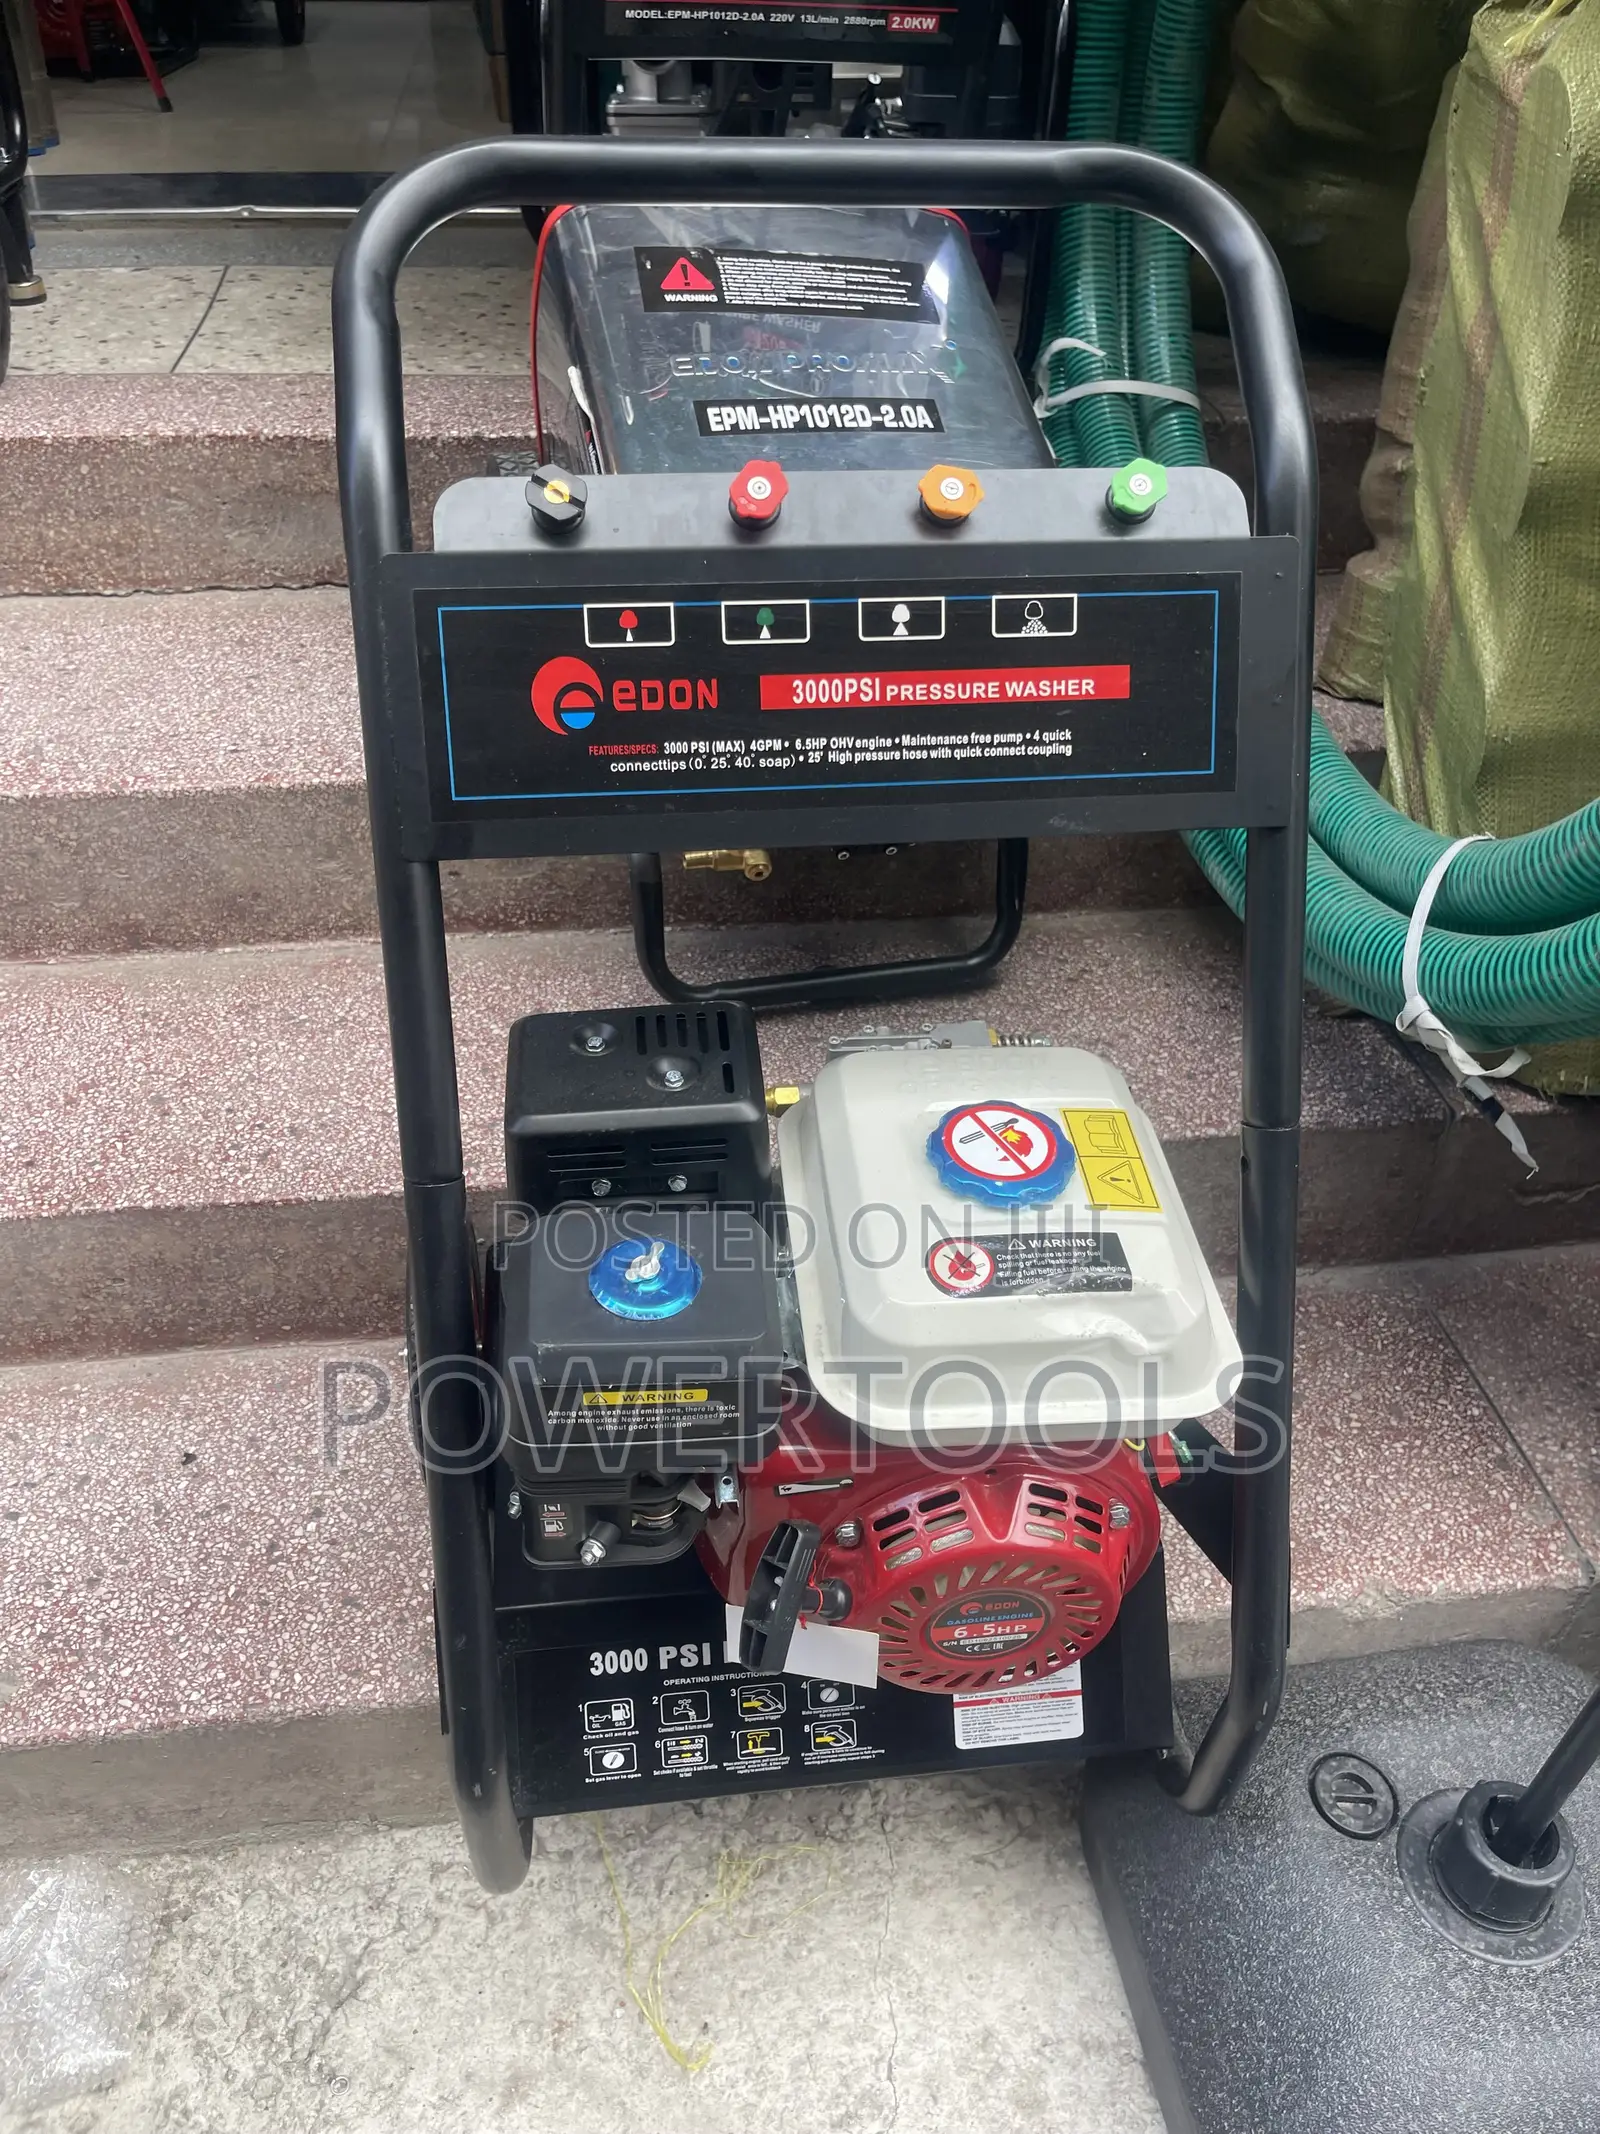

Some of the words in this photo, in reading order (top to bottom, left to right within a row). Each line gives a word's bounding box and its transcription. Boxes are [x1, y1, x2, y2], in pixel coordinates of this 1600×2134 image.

[770, 14, 795, 23] 220V
[800, 14, 838, 25] 13L/min
[891, 16, 936, 30] 2.0KW
[664, 293, 718, 303] WARNING
[706, 404, 935, 432] EPM-HP1012D-2.0A
[792, 677, 880, 704] 3000PSI
[886, 682, 1000, 702] PRESSURE
[1005, 679, 1095, 698] WASHER
[588, 744, 659, 756] FEATURES/SPECS:
[664, 742, 688, 754] 3000
[690, 741, 710, 754] PSI
[712, 740, 746, 755] (MAX)
[750, 740, 782, 752] 4GPM
[795, 738, 827, 750] 6.5HP
[830, 736, 854, 749] OHV
[855, 736, 892, 750] engine
[901, 733, 969, 747] Maintenance
[970, 732, 992, 745] free
[993, 732, 1023, 746] pump
[1033, 731, 1040, 742] 4
[1043, 729, 1072, 743] quick
[759, 754, 796, 770] soap)
[828, 750, 852, 764] High
[854, 750, 901, 764] pressure
[902, 748, 928, 760] hose
[928, 747, 952, 760] with
[953, 746, 982, 760] quick
[984, 745, 1026, 758] connect
[1026, 743, 1072, 757] coupling
[1028, 1238, 1097, 1248] WARNING
[1020, 1252, 1035, 1260] that
[1073, 1250, 1086, 1258] any
[998, 1260, 1024, 1269] spilling
[1034, 1258, 1048, 1266] fuel
[1023, 1268, 1037, 1276] fuel
[1102, 1264, 1127, 1273] engine
[622, 1392, 694, 1402] WARNING
[606, 1408, 639, 1416] exhaust
[578, 1416, 619, 1424] monoxide.
[628, 1423, 648, 1431] good
[947, 1616, 996, 1626] GASOLINE
[998, 1612, 1034, 1622] ENGINE
[589, 1648, 648, 1676] 3000
[658, 1642, 712, 1670] PSI
[663, 1676, 710, 1686] OPERATING
[800, 1681, 808, 1690] 4
[730, 1688, 736, 1697] 3
[652, 1696, 658, 1704] 2
[1002, 1694, 1040, 1702] WARNING
[578, 1704, 582, 1712] 1
[804, 1724, 810, 1733] 8
[730, 1730, 736, 1738] 7
[654, 1740, 661, 1748] 6
[583, 1748, 590, 1756] 5
